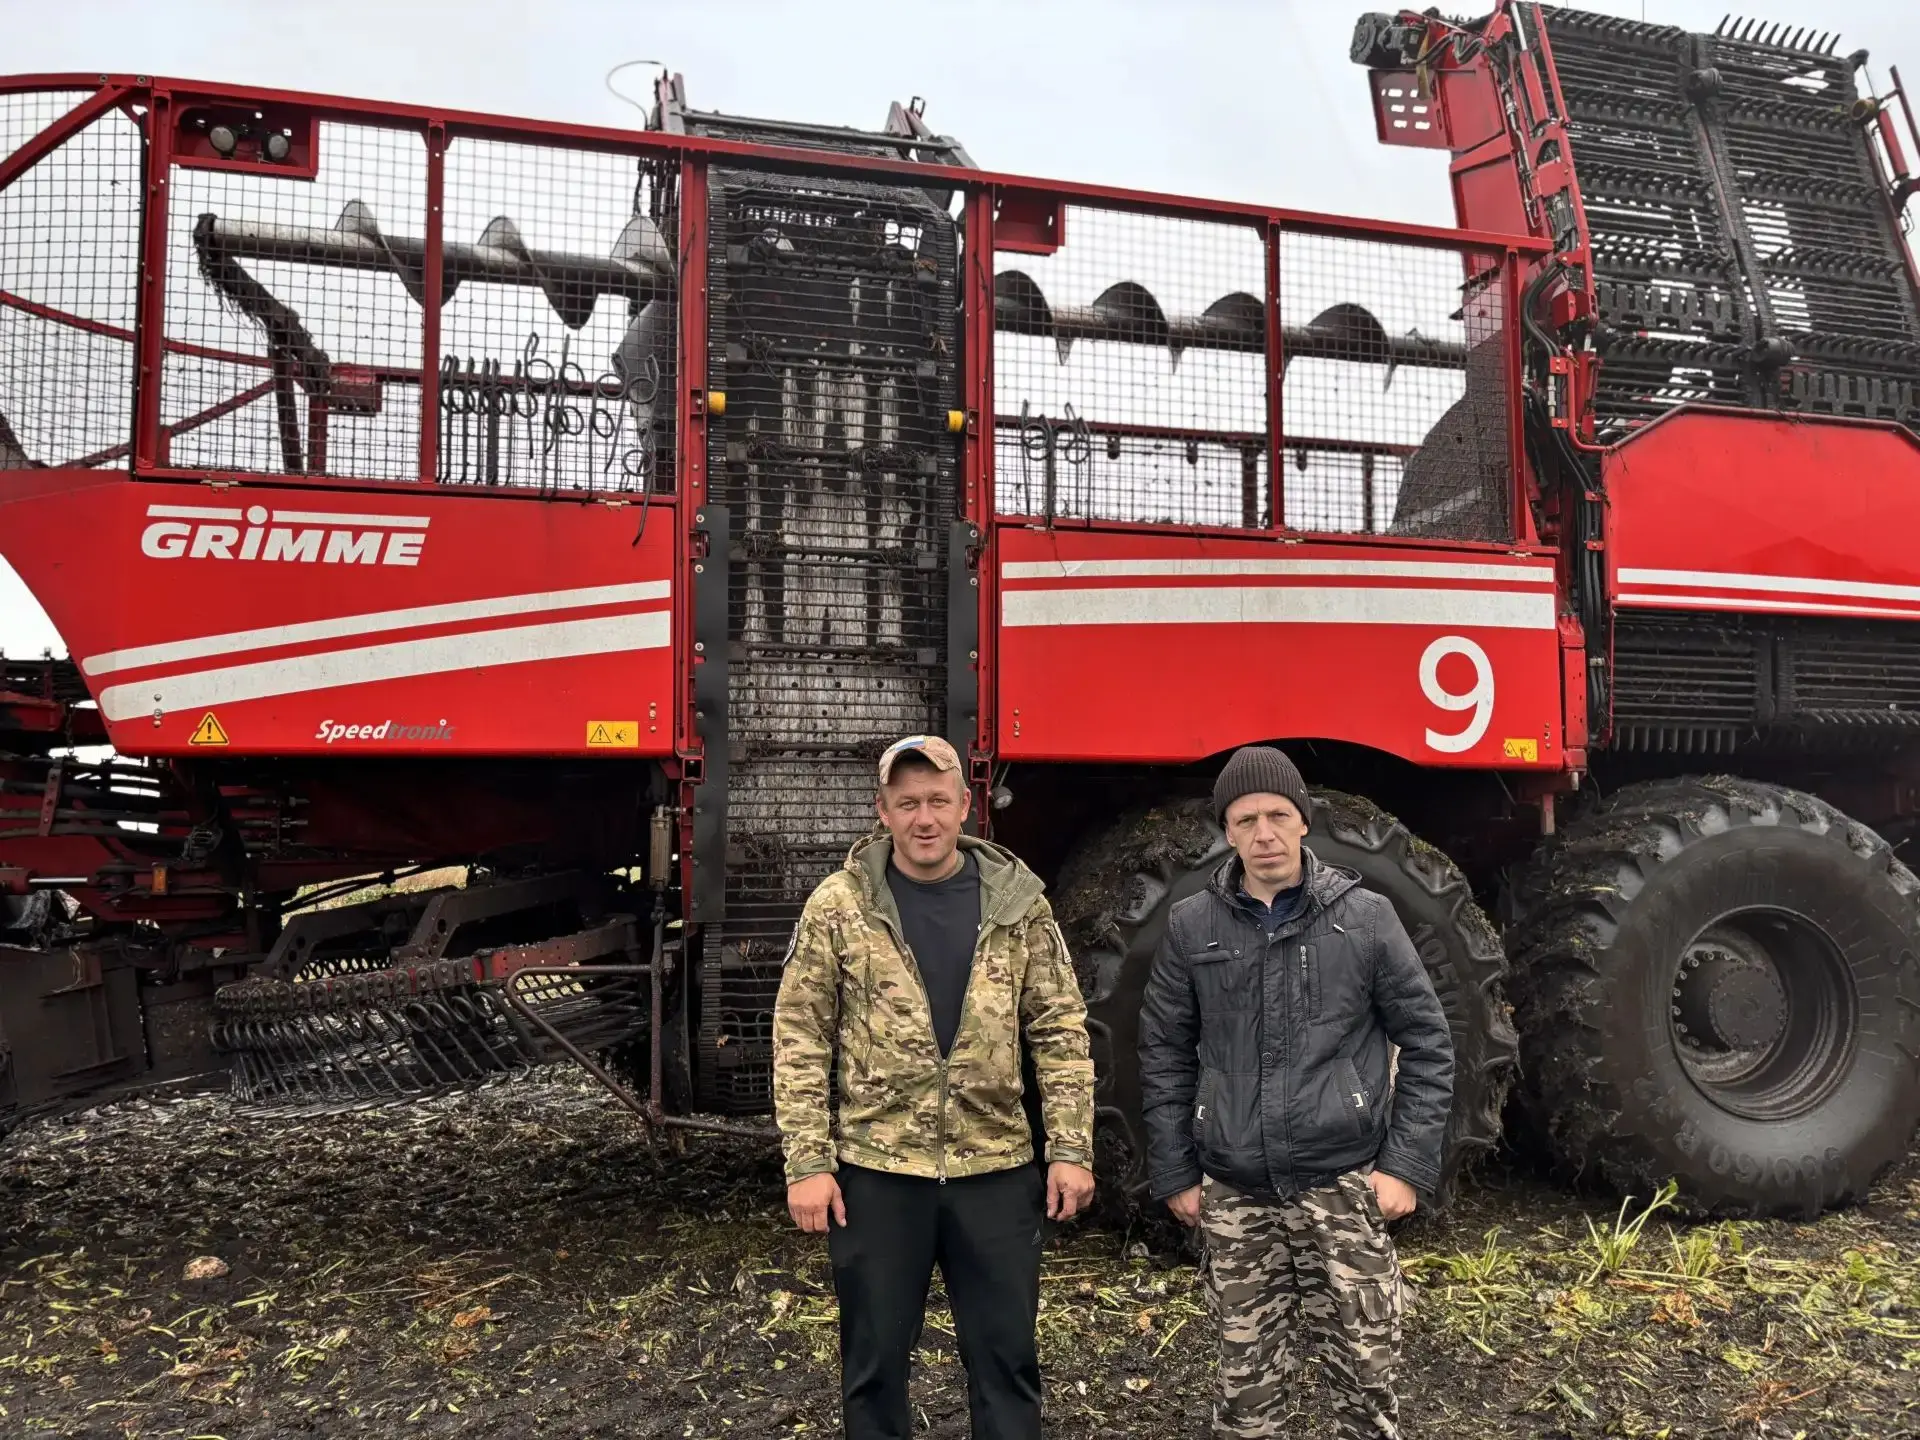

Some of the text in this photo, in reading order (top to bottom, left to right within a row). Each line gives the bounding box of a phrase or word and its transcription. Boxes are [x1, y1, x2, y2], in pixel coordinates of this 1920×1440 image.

[141, 505, 427, 566] GRIMME
[1419, 635, 1495, 753] 9
[315, 719, 457, 743] Speedtronic
